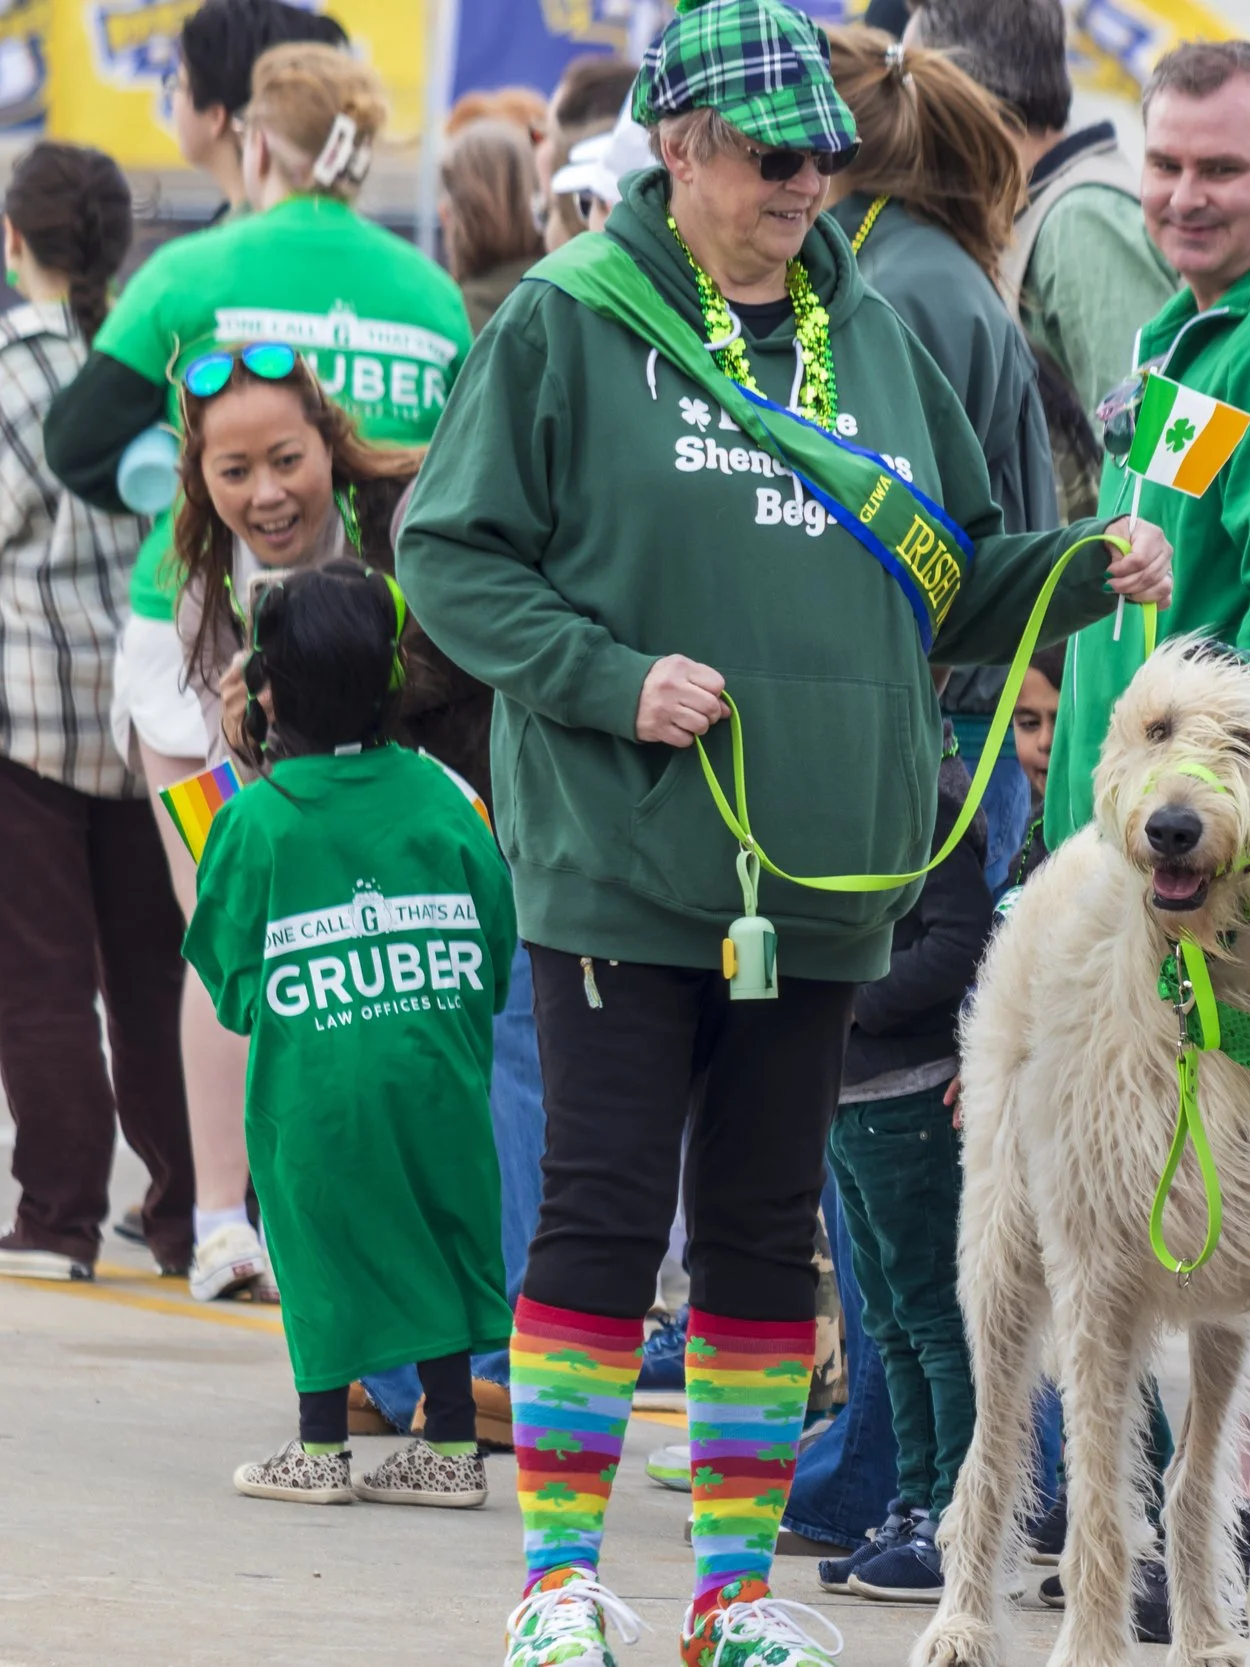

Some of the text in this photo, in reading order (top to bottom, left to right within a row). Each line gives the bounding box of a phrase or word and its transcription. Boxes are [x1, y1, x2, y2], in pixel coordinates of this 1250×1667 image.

[306, 350, 449, 410] UBER
[755, 487, 838, 537] Beg
[859, 475, 893, 523] GLIWA
[896, 513, 961, 609] IRISH
[301, 915, 351, 940] CALL
[361, 905, 380, 933] G
[395, 904, 448, 922] THAT'S
[453, 904, 477, 921] AL
[266, 939, 485, 1017] GRUBER
[315, 994, 462, 1032] LAW OFFICES LLC
